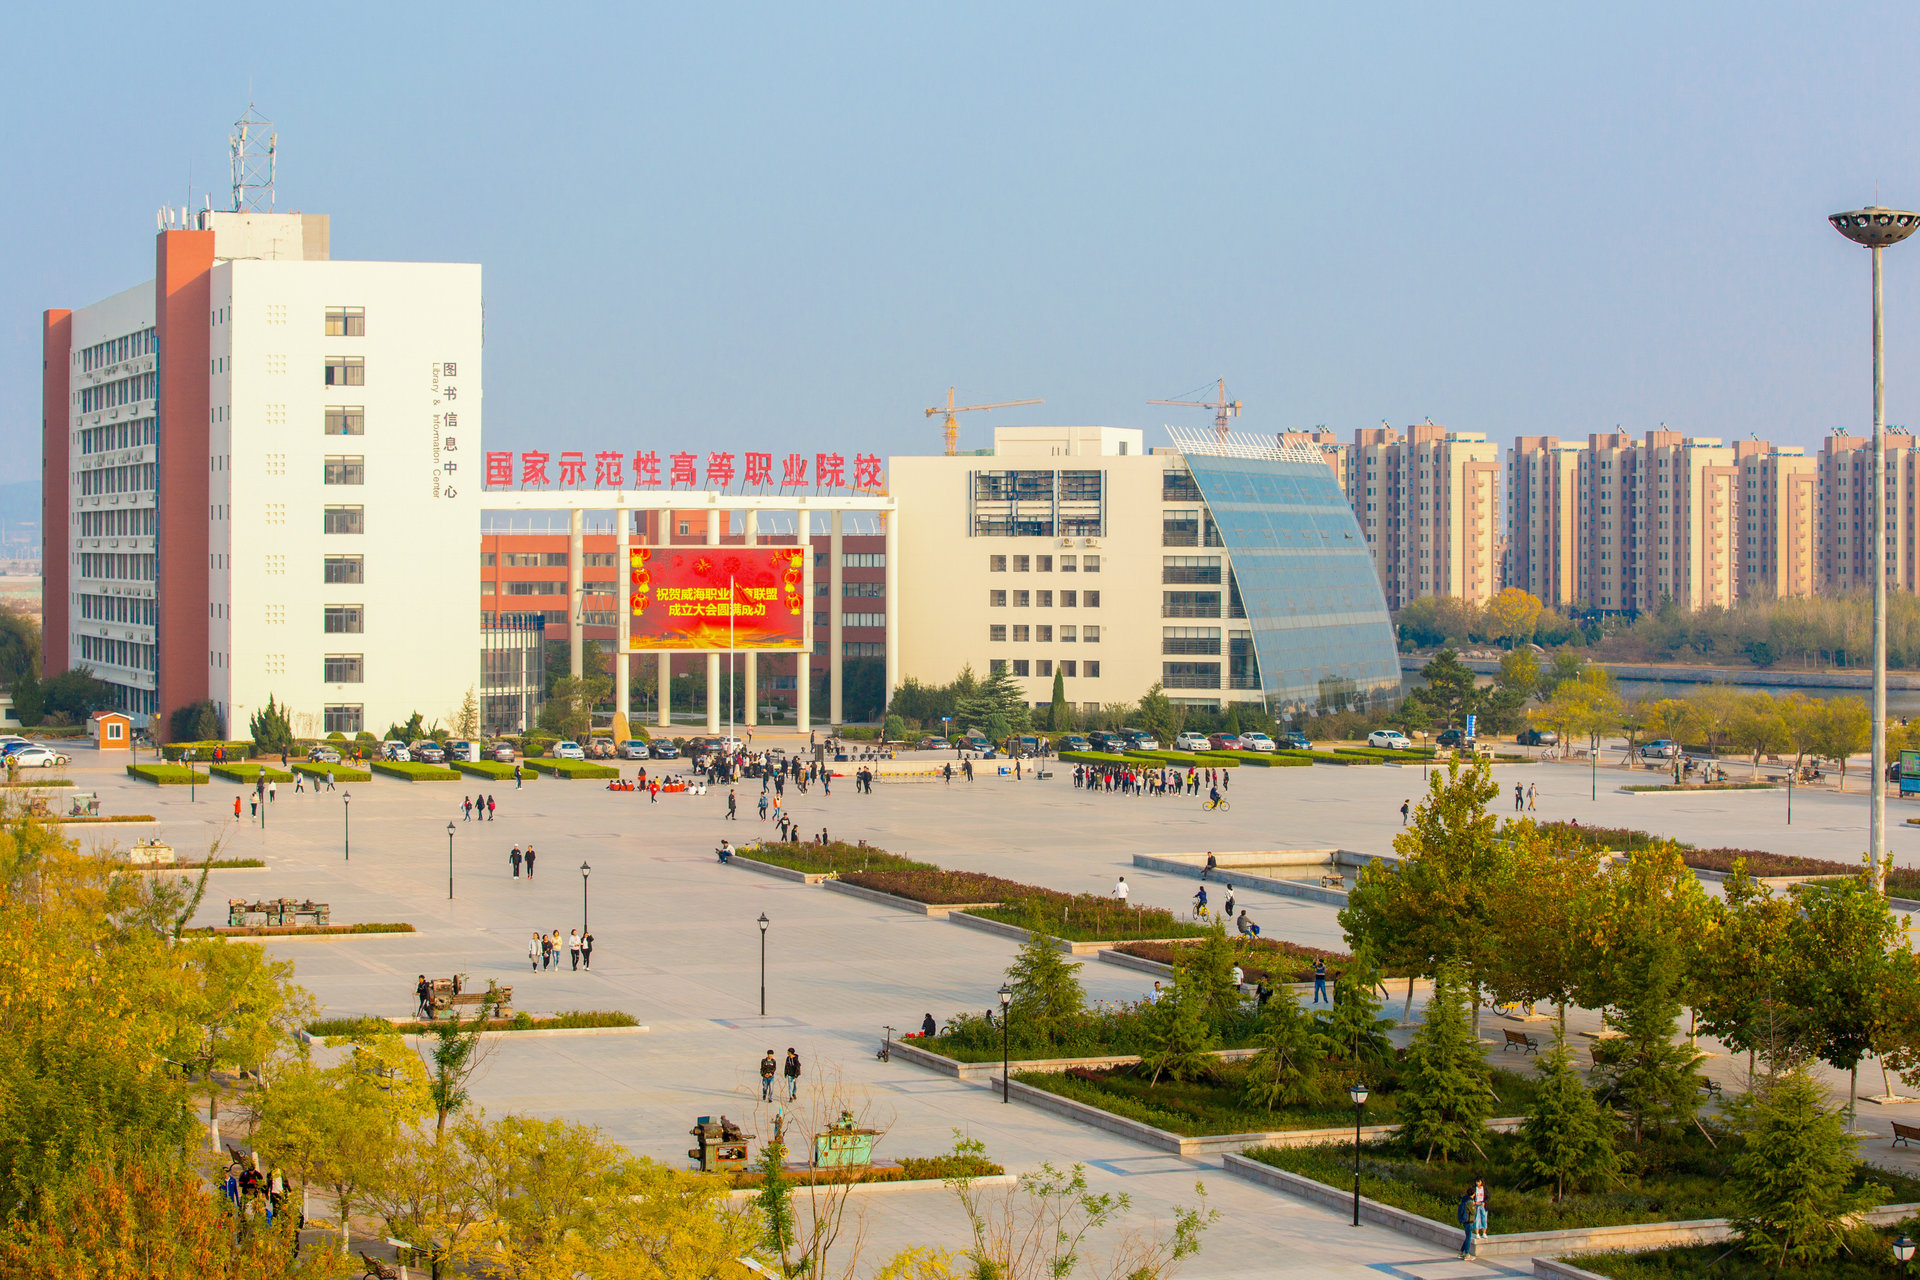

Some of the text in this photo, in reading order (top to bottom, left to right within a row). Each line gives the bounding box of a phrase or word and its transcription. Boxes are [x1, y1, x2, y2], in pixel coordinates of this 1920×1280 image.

[431, 362, 440, 393] Library
[432, 414, 441, 464] Information
[443, 362, 458, 499] 图书信息中心
[432, 468, 441, 499] Center
[485, 450, 882, 488] 国家示范性高等职业院校
[656, 587, 778, 601] 祝贺威海职业联盟
[668, 603, 766, 617] 成立大会圆满成功
